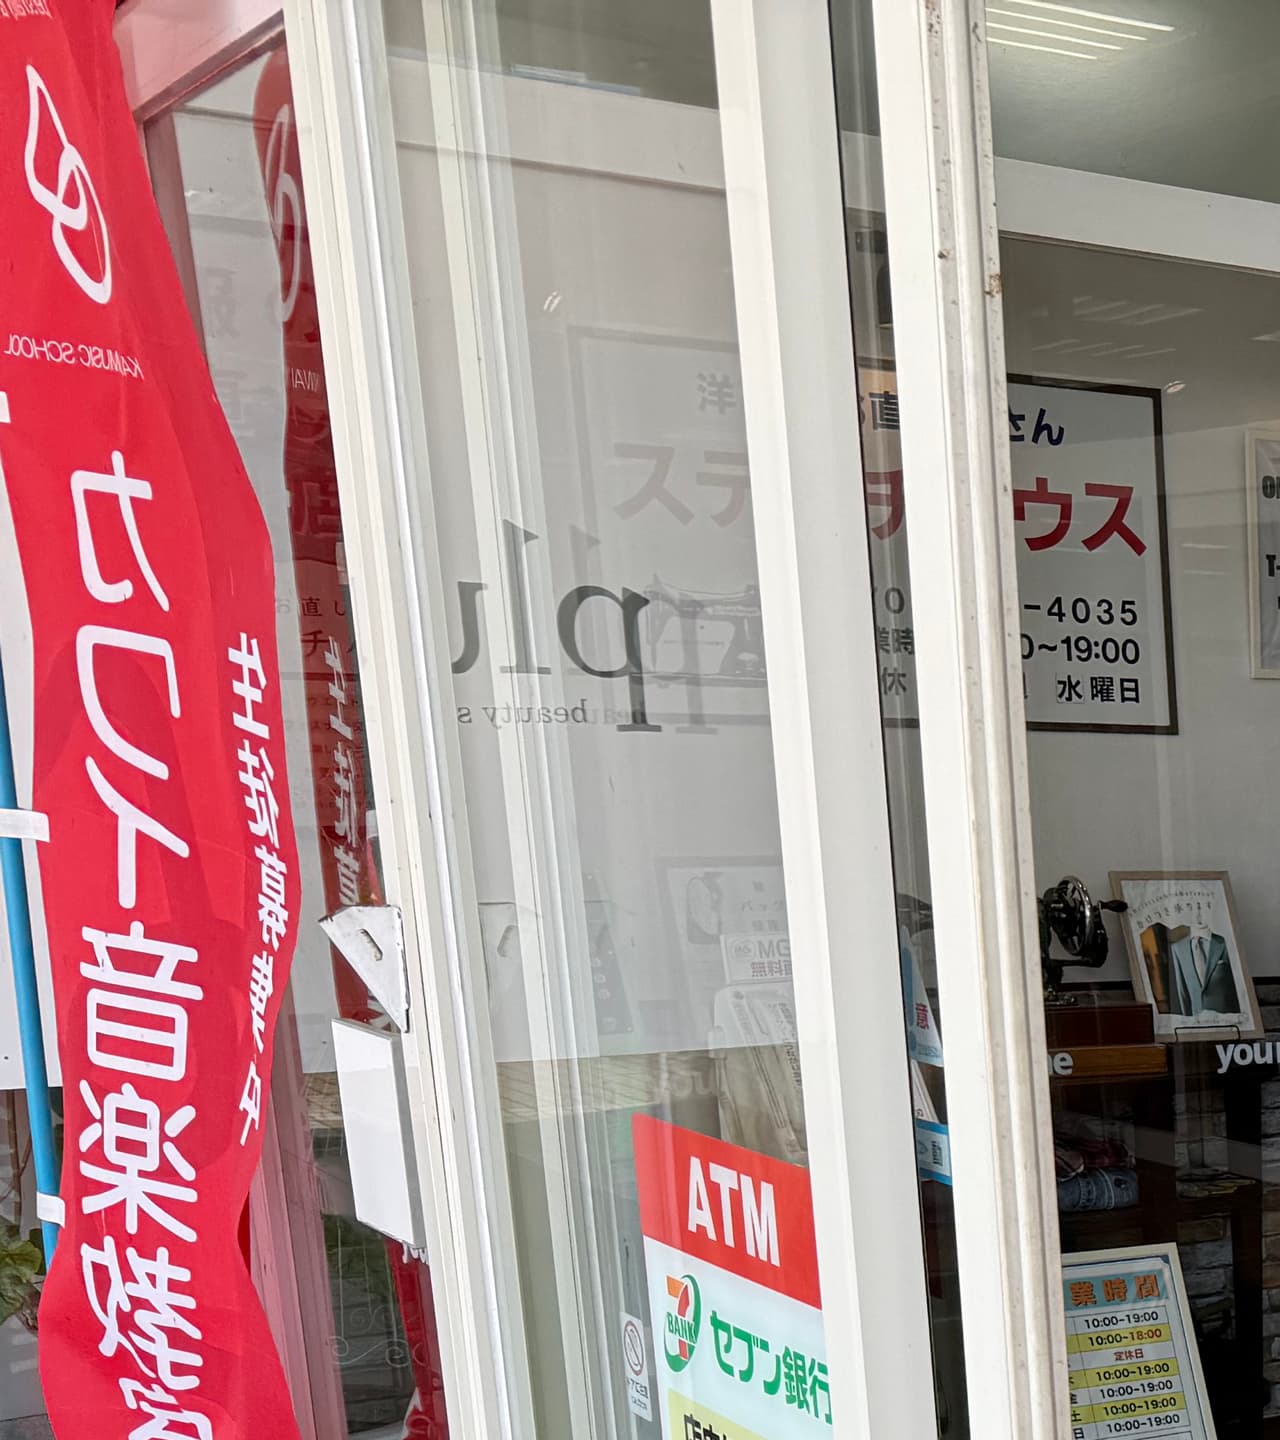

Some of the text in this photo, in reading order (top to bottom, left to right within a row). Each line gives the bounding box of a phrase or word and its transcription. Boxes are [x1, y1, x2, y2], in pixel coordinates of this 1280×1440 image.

[1057, 675, 1141, 704] 水曜日
[687, 1156, 781, 1268] ATM
[667, 1311, 697, 1346] BANK
[710, 1309, 832, 1426] セブン銀行
[1113, 1349, 1144, 1361] 定休日
